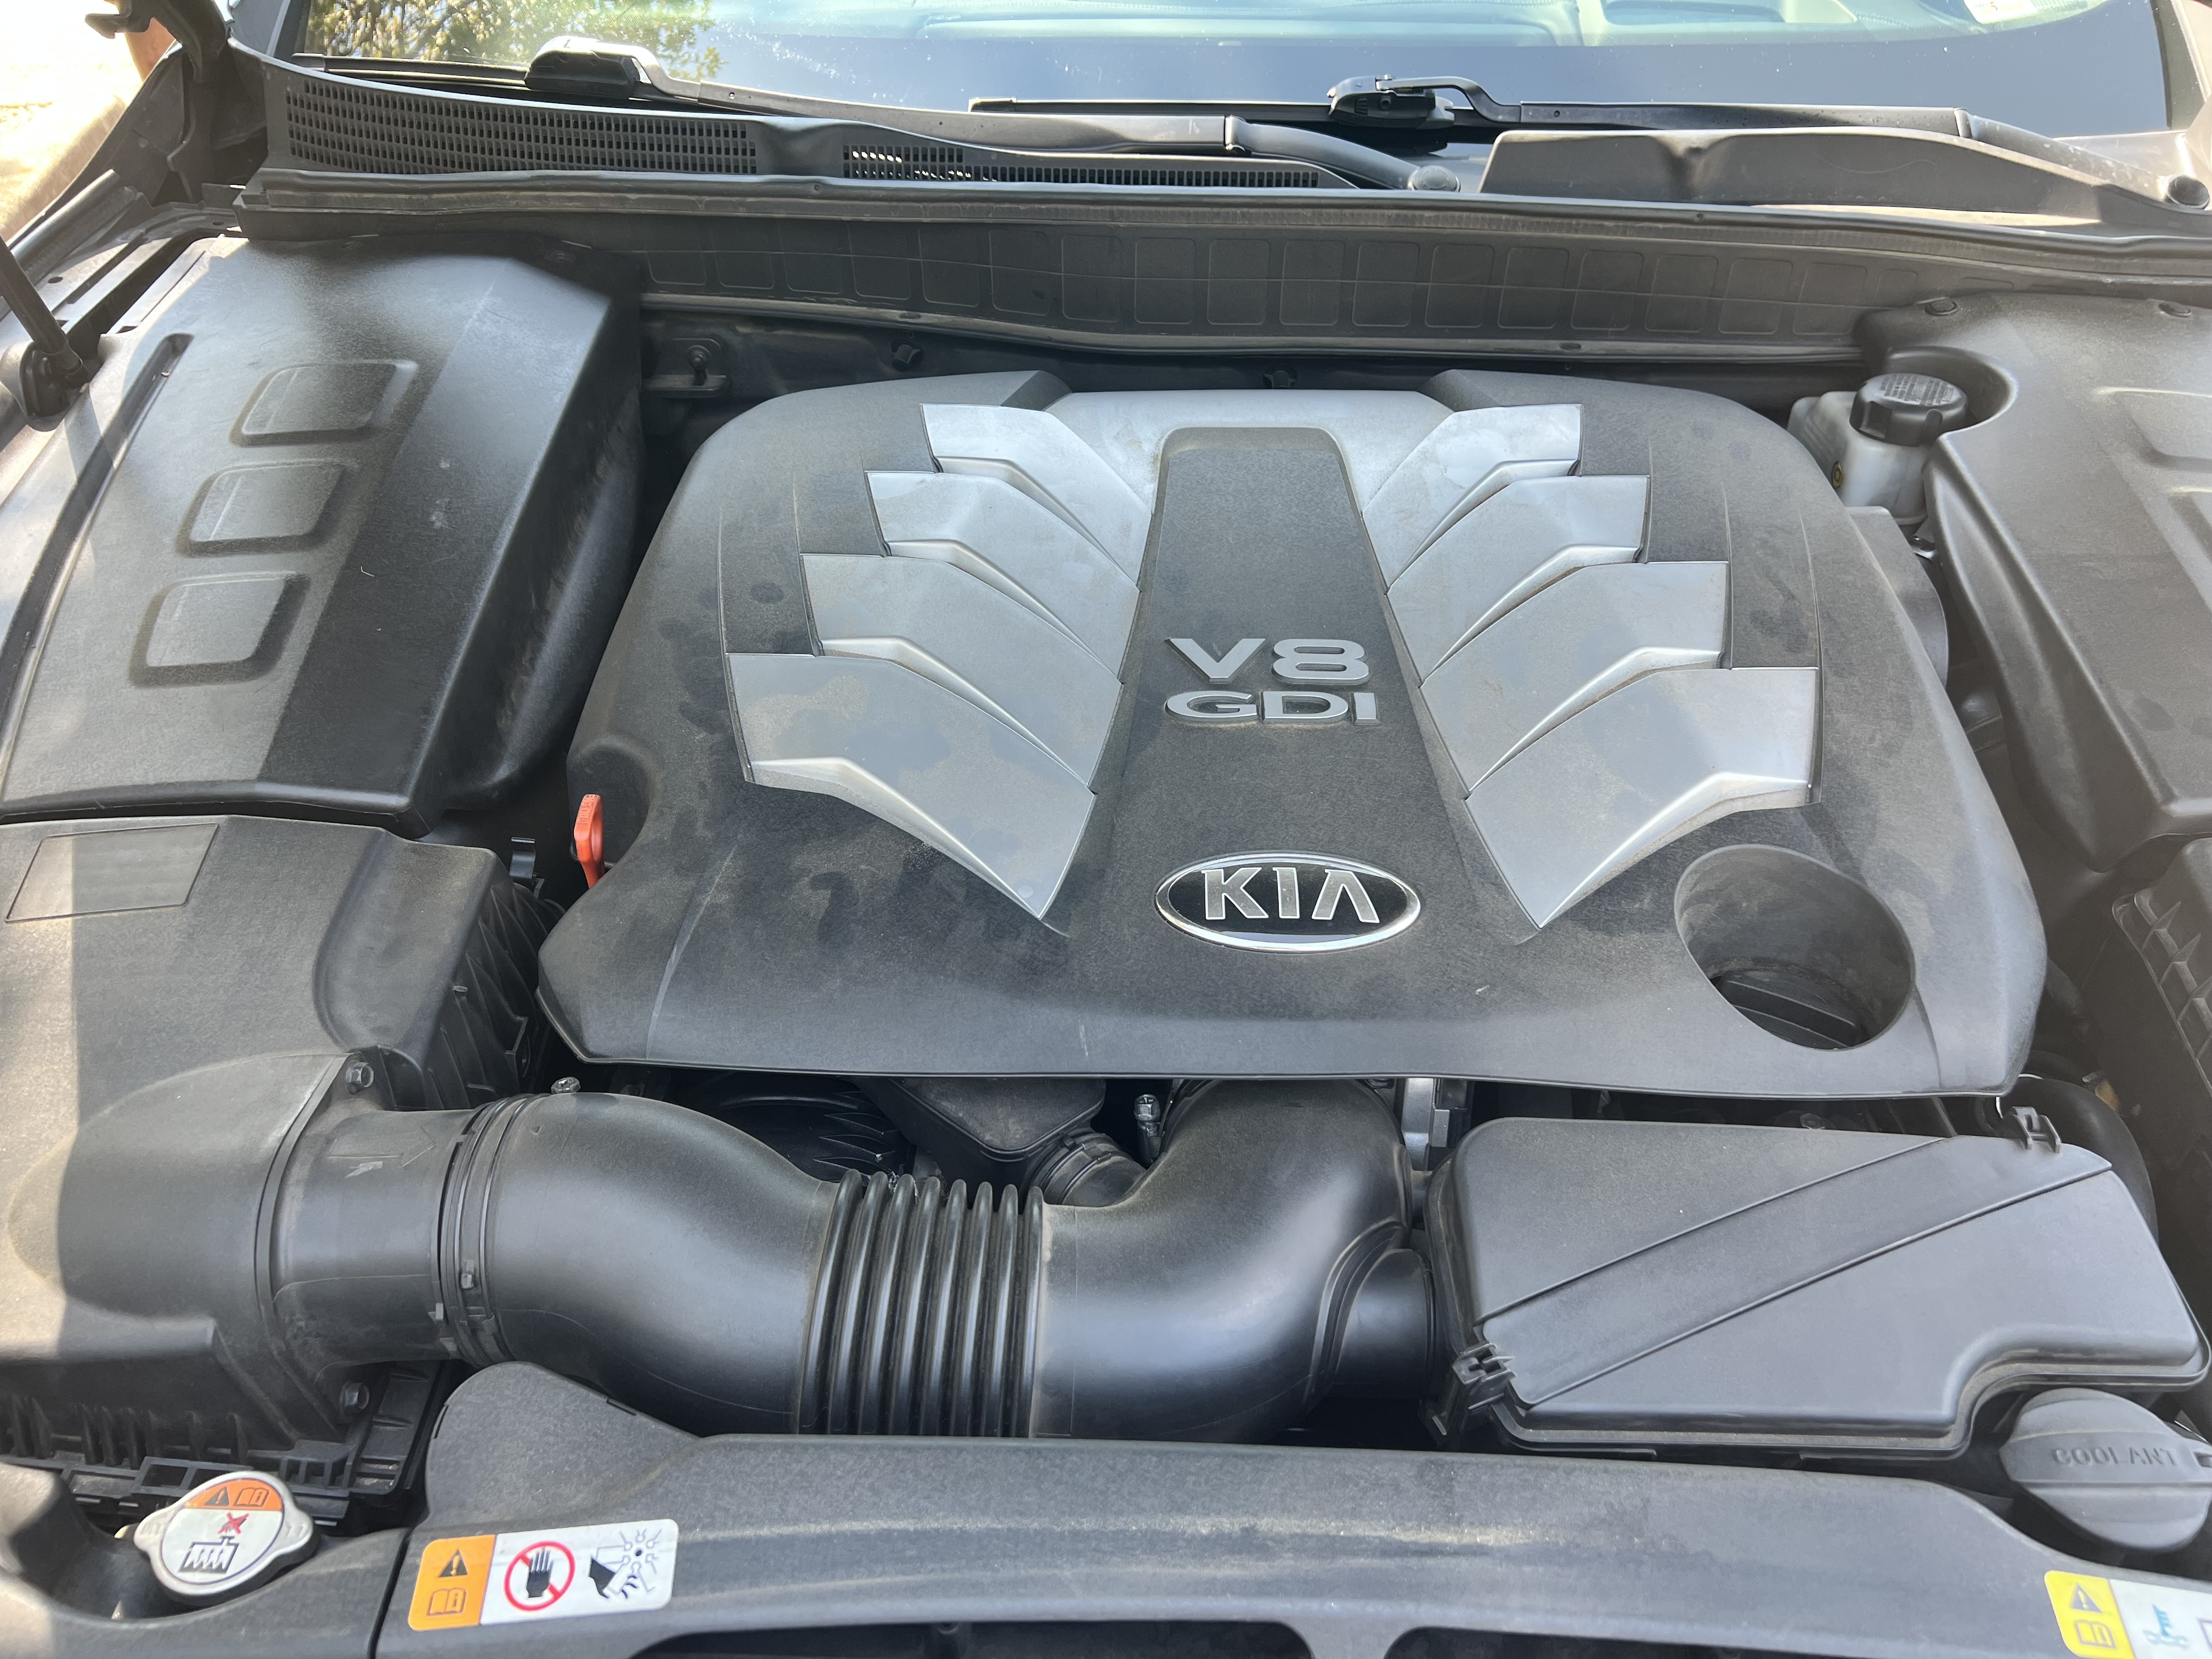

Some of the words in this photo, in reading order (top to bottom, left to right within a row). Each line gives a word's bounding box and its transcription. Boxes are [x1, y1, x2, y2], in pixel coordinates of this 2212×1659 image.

[1164, 637, 1372, 685] V8
[1164, 690, 1379, 725] GDI
[1201, 867, 1380, 923] KIA
[2052, 1447, 2176, 1465] COOLANT
